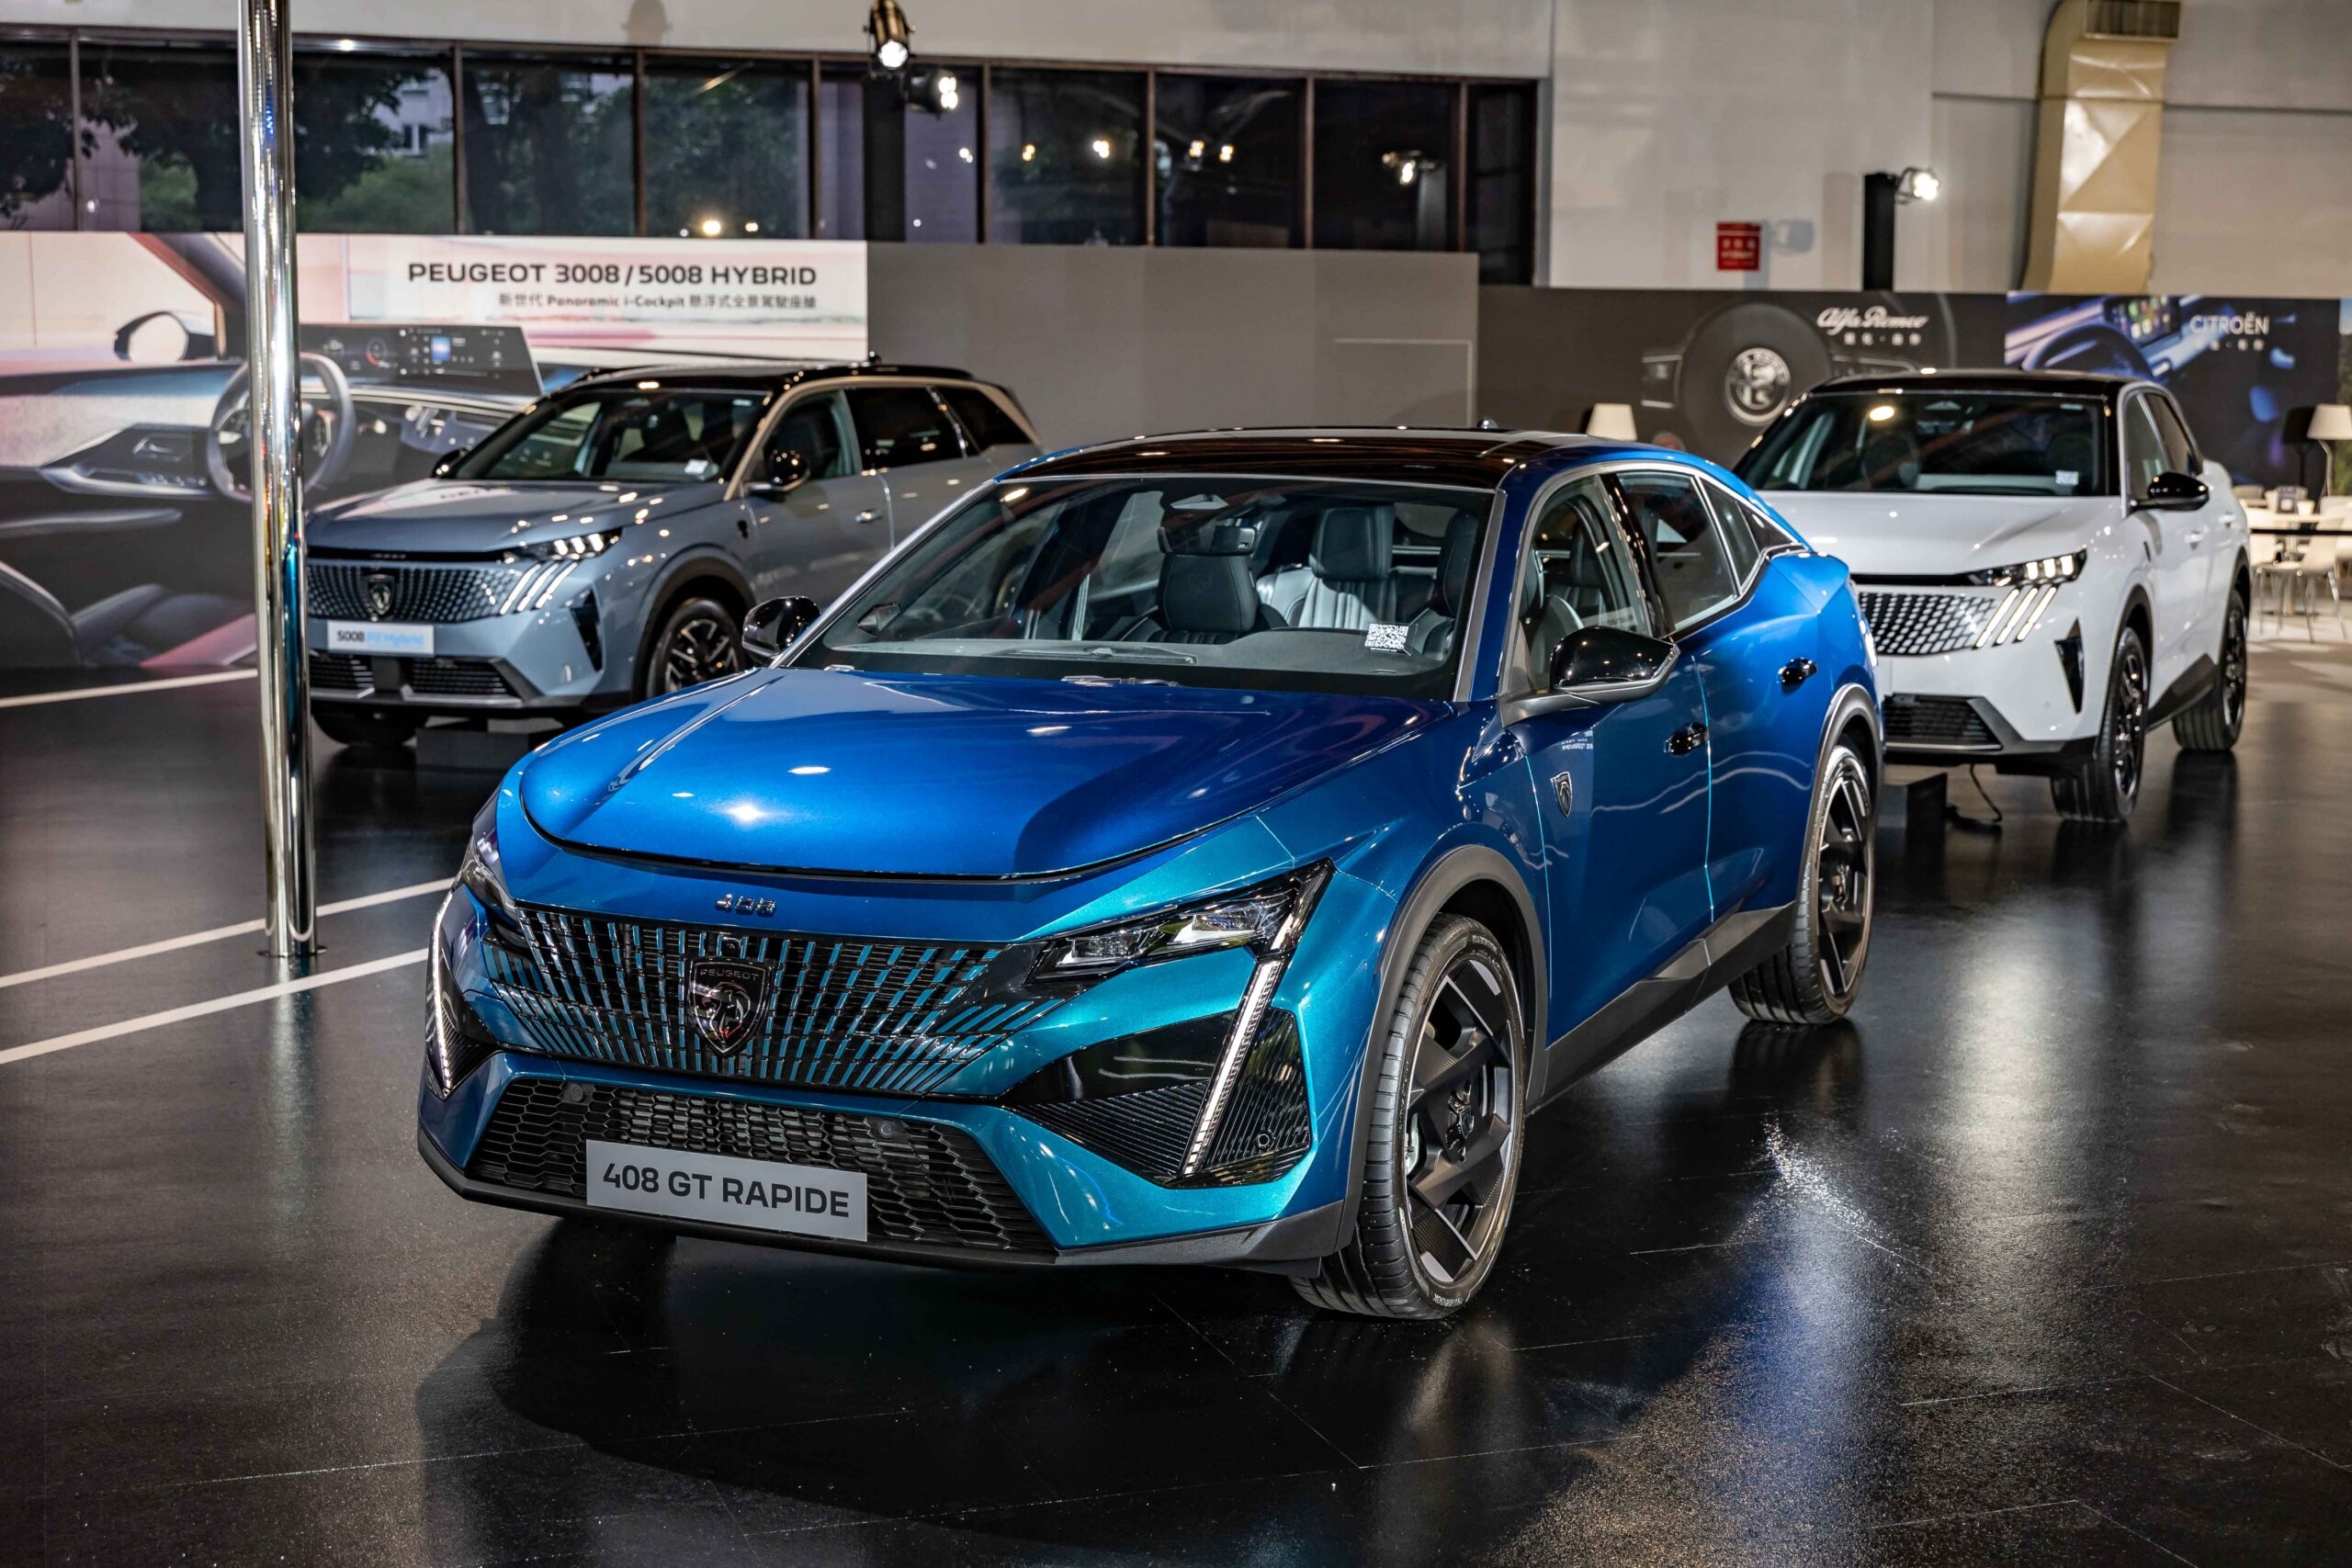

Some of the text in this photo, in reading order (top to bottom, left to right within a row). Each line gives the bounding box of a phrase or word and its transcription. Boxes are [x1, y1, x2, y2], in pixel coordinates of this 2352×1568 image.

[409, 263, 546, 283] PEUGEOT
[711, 266, 817, 286] HYBRID
[2189, 310, 2270, 335] CITROËN
[336, 630, 365, 642] 5008
[715, 893, 776, 915] 408
[699, 968, 761, 982] PEUGEOT
[603, 1163, 849, 1218] 408 GT RAPIDE
